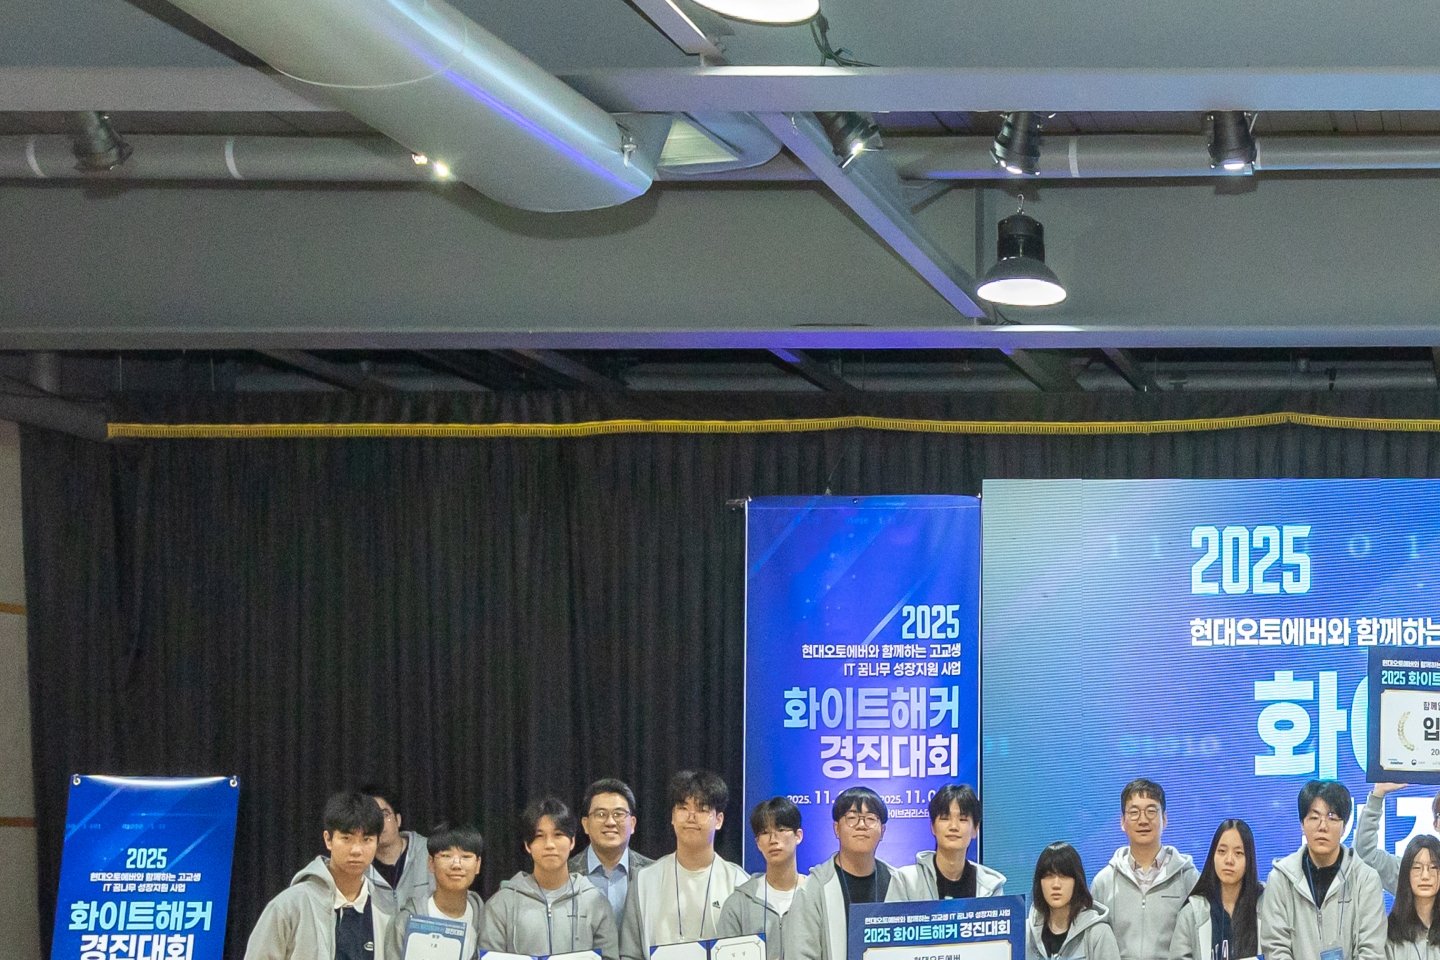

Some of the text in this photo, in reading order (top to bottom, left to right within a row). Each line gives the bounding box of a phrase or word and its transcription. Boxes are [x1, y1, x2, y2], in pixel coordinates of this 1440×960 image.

[1191, 525, 1312, 594] 2025
[902, 605, 960, 639] 2025
[1189, 617, 1351, 647] 현대오토에버와
[802, 643, 961, 658] 현대오토에버와 함께하는 고교생
[844, 662, 961, 676] IT 꿈나무 성장지원 사업
[1382, 671, 1406, 685] 2025
[784, 686, 959, 730] 화이트해커
[820, 734, 958, 779] 경진대회
[126, 848, 167, 868] 2025
[103, 884, 111, 892] IT
[170, 884, 186, 892] 사업
[178, 873, 201, 881] 고교생
[69, 901, 212, 931] 화이트해커
[864, 920, 1010, 943] 2025 화이트해커 경진대회
